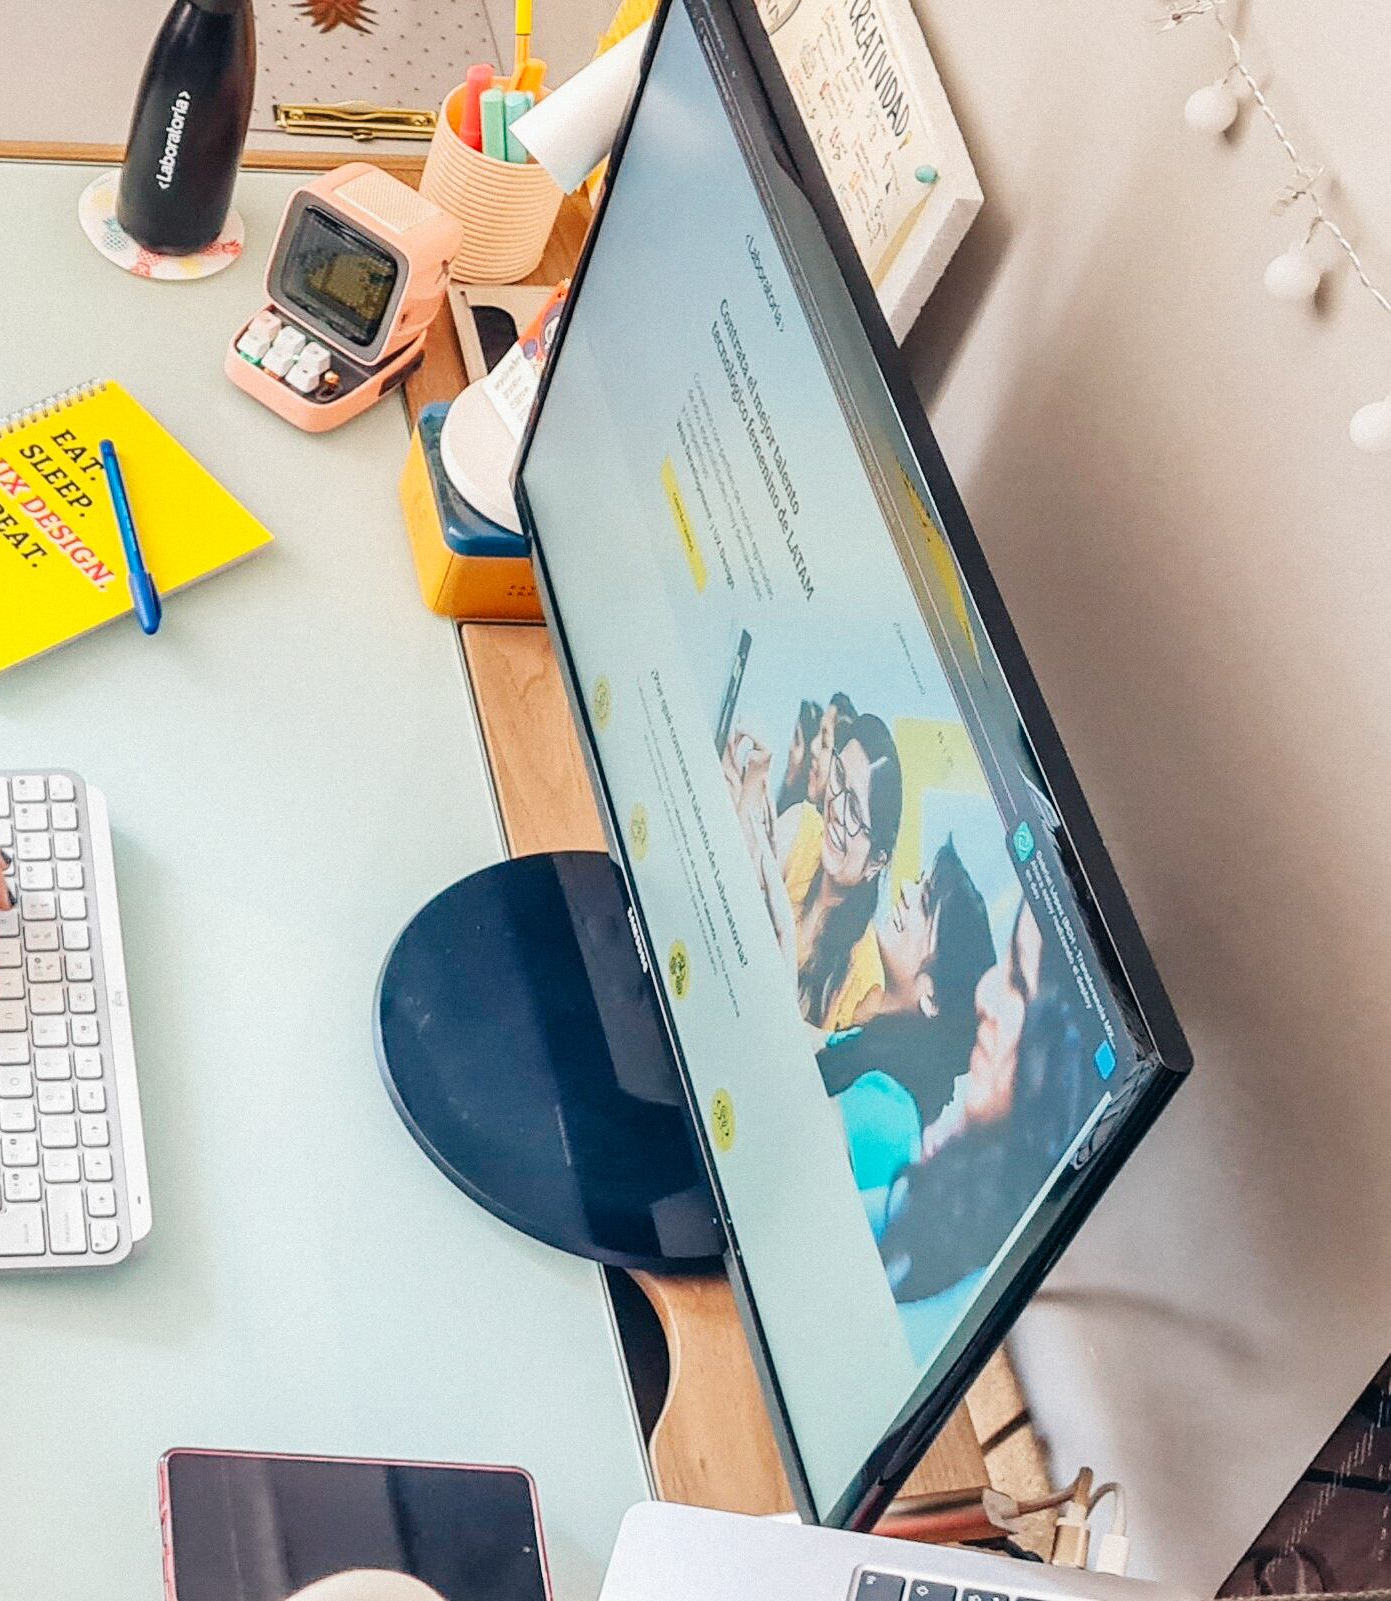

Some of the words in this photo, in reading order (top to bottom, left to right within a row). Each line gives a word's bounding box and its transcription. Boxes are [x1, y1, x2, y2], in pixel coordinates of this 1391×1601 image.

[50, 428, 104, 481] EAT.
[712, 322, 748, 421] tecnológico
[746, 419, 779, 508] femenino
[777, 508, 788, 534] de
[787, 531, 814, 600] LATAM
[720, 299, 748, 377] Contrata
[747, 376, 757, 395] el
[753, 393, 774, 447] mejor
[774, 446, 799, 515] talento
[19, 443, 93, 518] SLEEP.
[20, 497, 115, 590] DESIGN.
[670, 727, 692, 793] contratar
[691, 794, 709, 850] talento
